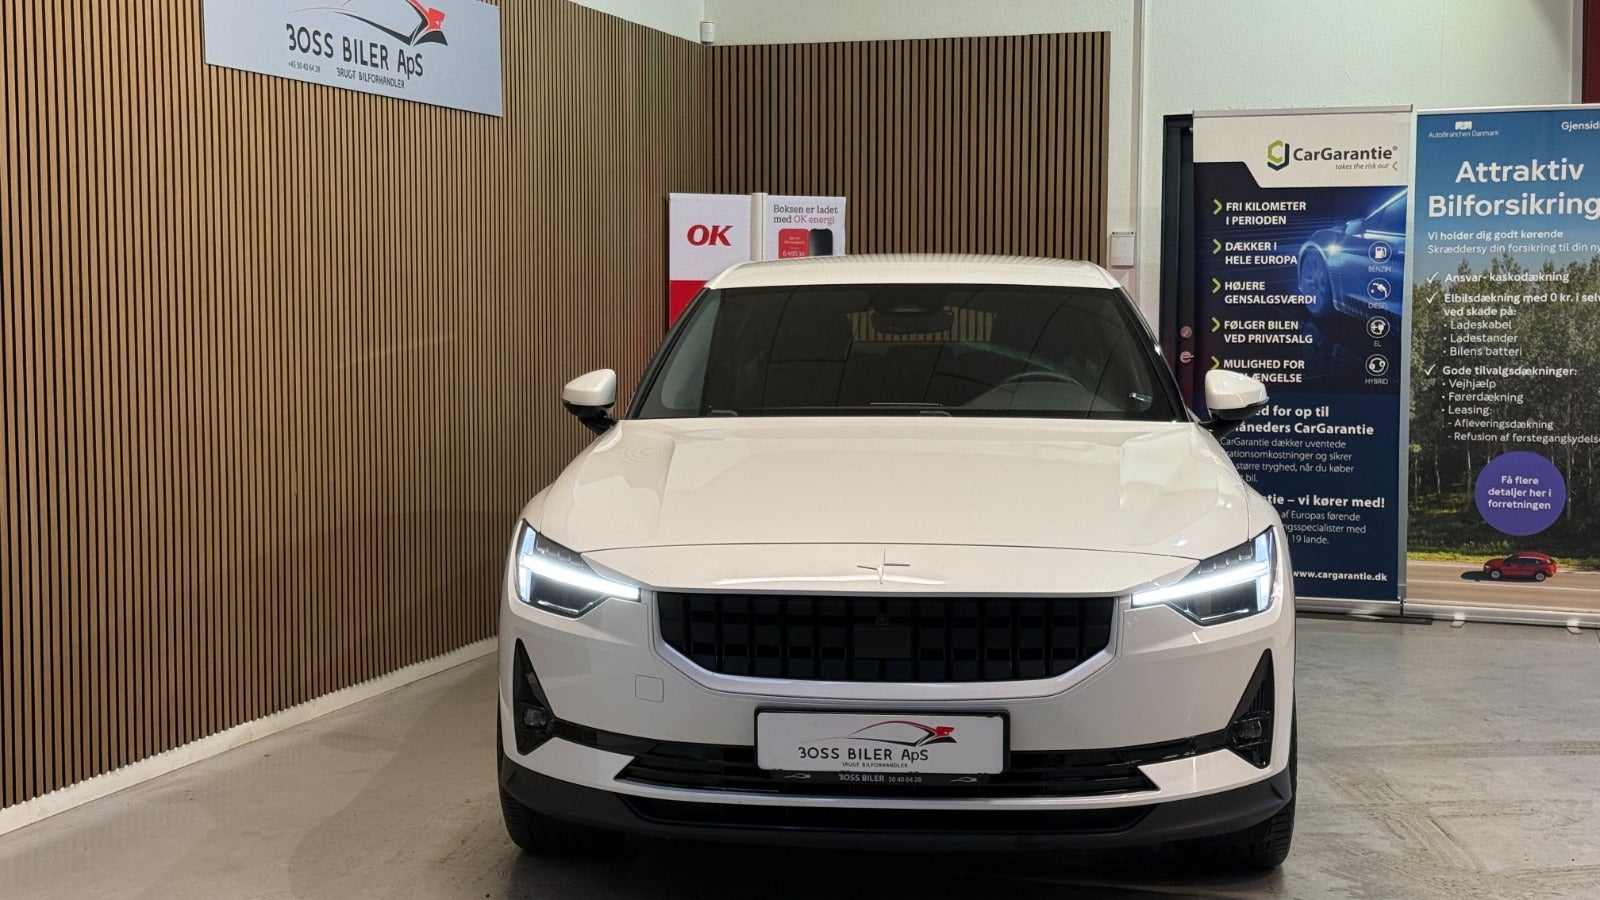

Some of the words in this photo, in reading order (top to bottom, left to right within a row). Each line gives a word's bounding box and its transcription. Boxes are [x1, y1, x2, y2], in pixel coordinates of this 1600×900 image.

[342, 37, 389, 70] BILER
[397, 49, 424, 80] ApS
[358, 72, 405, 88] BILFORHANDLER
[1561, 121, 1600, 132] Gjensid
[1428, 130, 1470, 138] AutoBranchen
[1365, 162, 1377, 170] risk
[1455, 158, 1584, 183] Attraktiv
[774, 205, 804, 214] Boksen
[817, 205, 838, 214] ladet
[1226, 202, 1242, 211] FRI
[1244, 202, 1306, 211] KILOMETER
[1428, 192, 1600, 220] Bilforsikring
[774, 215, 792, 223] med
[808, 216, 835, 226] energi
[1226, 216, 1229, 225] I
[1232, 216, 1286, 225] PERIODEN
[687, 224, 733, 246] OK
[1428, 232, 1438, 240] Vi
[1440, 231, 1474, 240] holder
[1476, 231, 1492, 241] dig
[1494, 230, 1518, 241] godt
[1521, 230, 1564, 239] kørende
[1225, 242, 1271, 251] DÆKKER
[1274, 242, 1277, 250] I
[1427, 244, 1487, 254] Skræddersy
[1490, 244, 1505, 253] din
[1508, 244, 1556, 254] forsikring
[1558, 243, 1569, 252] til
[1571, 243, 1588, 252] din
[1225, 255, 1252, 265] HELE
[1254, 255, 1298, 265] EUROPA
[1445, 274, 1486, 282] Ansvar-
[1490, 272, 1569, 283] kaskodækning
[1225, 280, 1266, 291] HØJERE
[1224, 294, 1316, 304] GENSALGSVÆRDI
[1444, 294, 1520, 304] Elbilsdækning
[1523, 293, 1547, 302] med
[1550, 293, 1556, 302] 0
[1560, 293, 1573, 302] kr.
[1576, 292, 1579, 302] i
[1444, 307, 1463, 316] ved
[1466, 307, 1497, 316] skade
[1500, 306, 1517, 317] på:
[1224, 320, 1265, 330] FØLGER
[1268, 320, 1299, 330] BILEN
[1450, 320, 1512, 330] Ladeskabel
[1224, 334, 1246, 344] VED
[1248, 334, 1313, 344] PRIVATSALG
[1450, 334, 1518, 343] Ladestander
[1450, 347, 1482, 356] Bilens
[1486, 347, 1522, 356] batteri
[1224, 360, 1281, 369] MULIGHED
[1284, 360, 1305, 369] FOR
[1239, 373, 1302, 382] ÆNGELSE
[1442, 366, 1472, 375] Gode
[1474, 366, 1578, 378] tilvalgsdækninger:
[1449, 378, 1496, 390] Vejhjælp
[1448, 392, 1524, 404] Førerdækning
[1273, 405, 1292, 416] for
[1295, 408, 1312, 420] op
[1315, 406, 1329, 417] til
[1448, 406, 1492, 416] Leasing:
[1236, 421, 1291, 433] åneders
[1294, 423, 1374, 435] CarGarantie
[1454, 419, 1554, 430] Afleveringsdækning
[1220, 438, 1269, 447] CarGarantie
[1271, 438, 1303, 447] dækker
[1305, 440, 1346, 448] uventede
[1454, 432, 1497, 441] Refusion
[1500, 433, 1509, 442] af
[1512, 433, 1600, 445] førstegangsydels
[1316, 453, 1327, 462] og
[1329, 452, 1352, 460] sikrer
[1236, 462, 1260, 471] større
[1262, 462, 1298, 473] tryghed,
[1300, 464, 1314, 472] når
[1316, 464, 1327, 472] du
[1329, 464, 1354, 473] køber
[1246, 474, 1258, 482] bil.
[1501, 476, 1513, 485] Få
[1515, 476, 1539, 485] flere
[1488, 488, 1528, 498] detaljer
[1529, 488, 1547, 497] her
[1548, 488, 1552, 497] i
[1298, 494, 1310, 505] vi
[1313, 495, 1348, 507] kører
[1352, 497, 1385, 508] med!
[1488, 500, 1551, 511] forretningen
[1281, 510, 1290, 518] af
[1291, 511, 1325, 521] Europas
[1327, 512, 1361, 521] førende
[1283, 523, 1344, 533] ngsspecialister
[1346, 524, 1366, 533] med
[1292, 534, 1302, 543] 19
[1304, 534, 1329, 544] lande.
[848, 748, 892, 760] BILER
[901, 750, 928, 763] ApS
